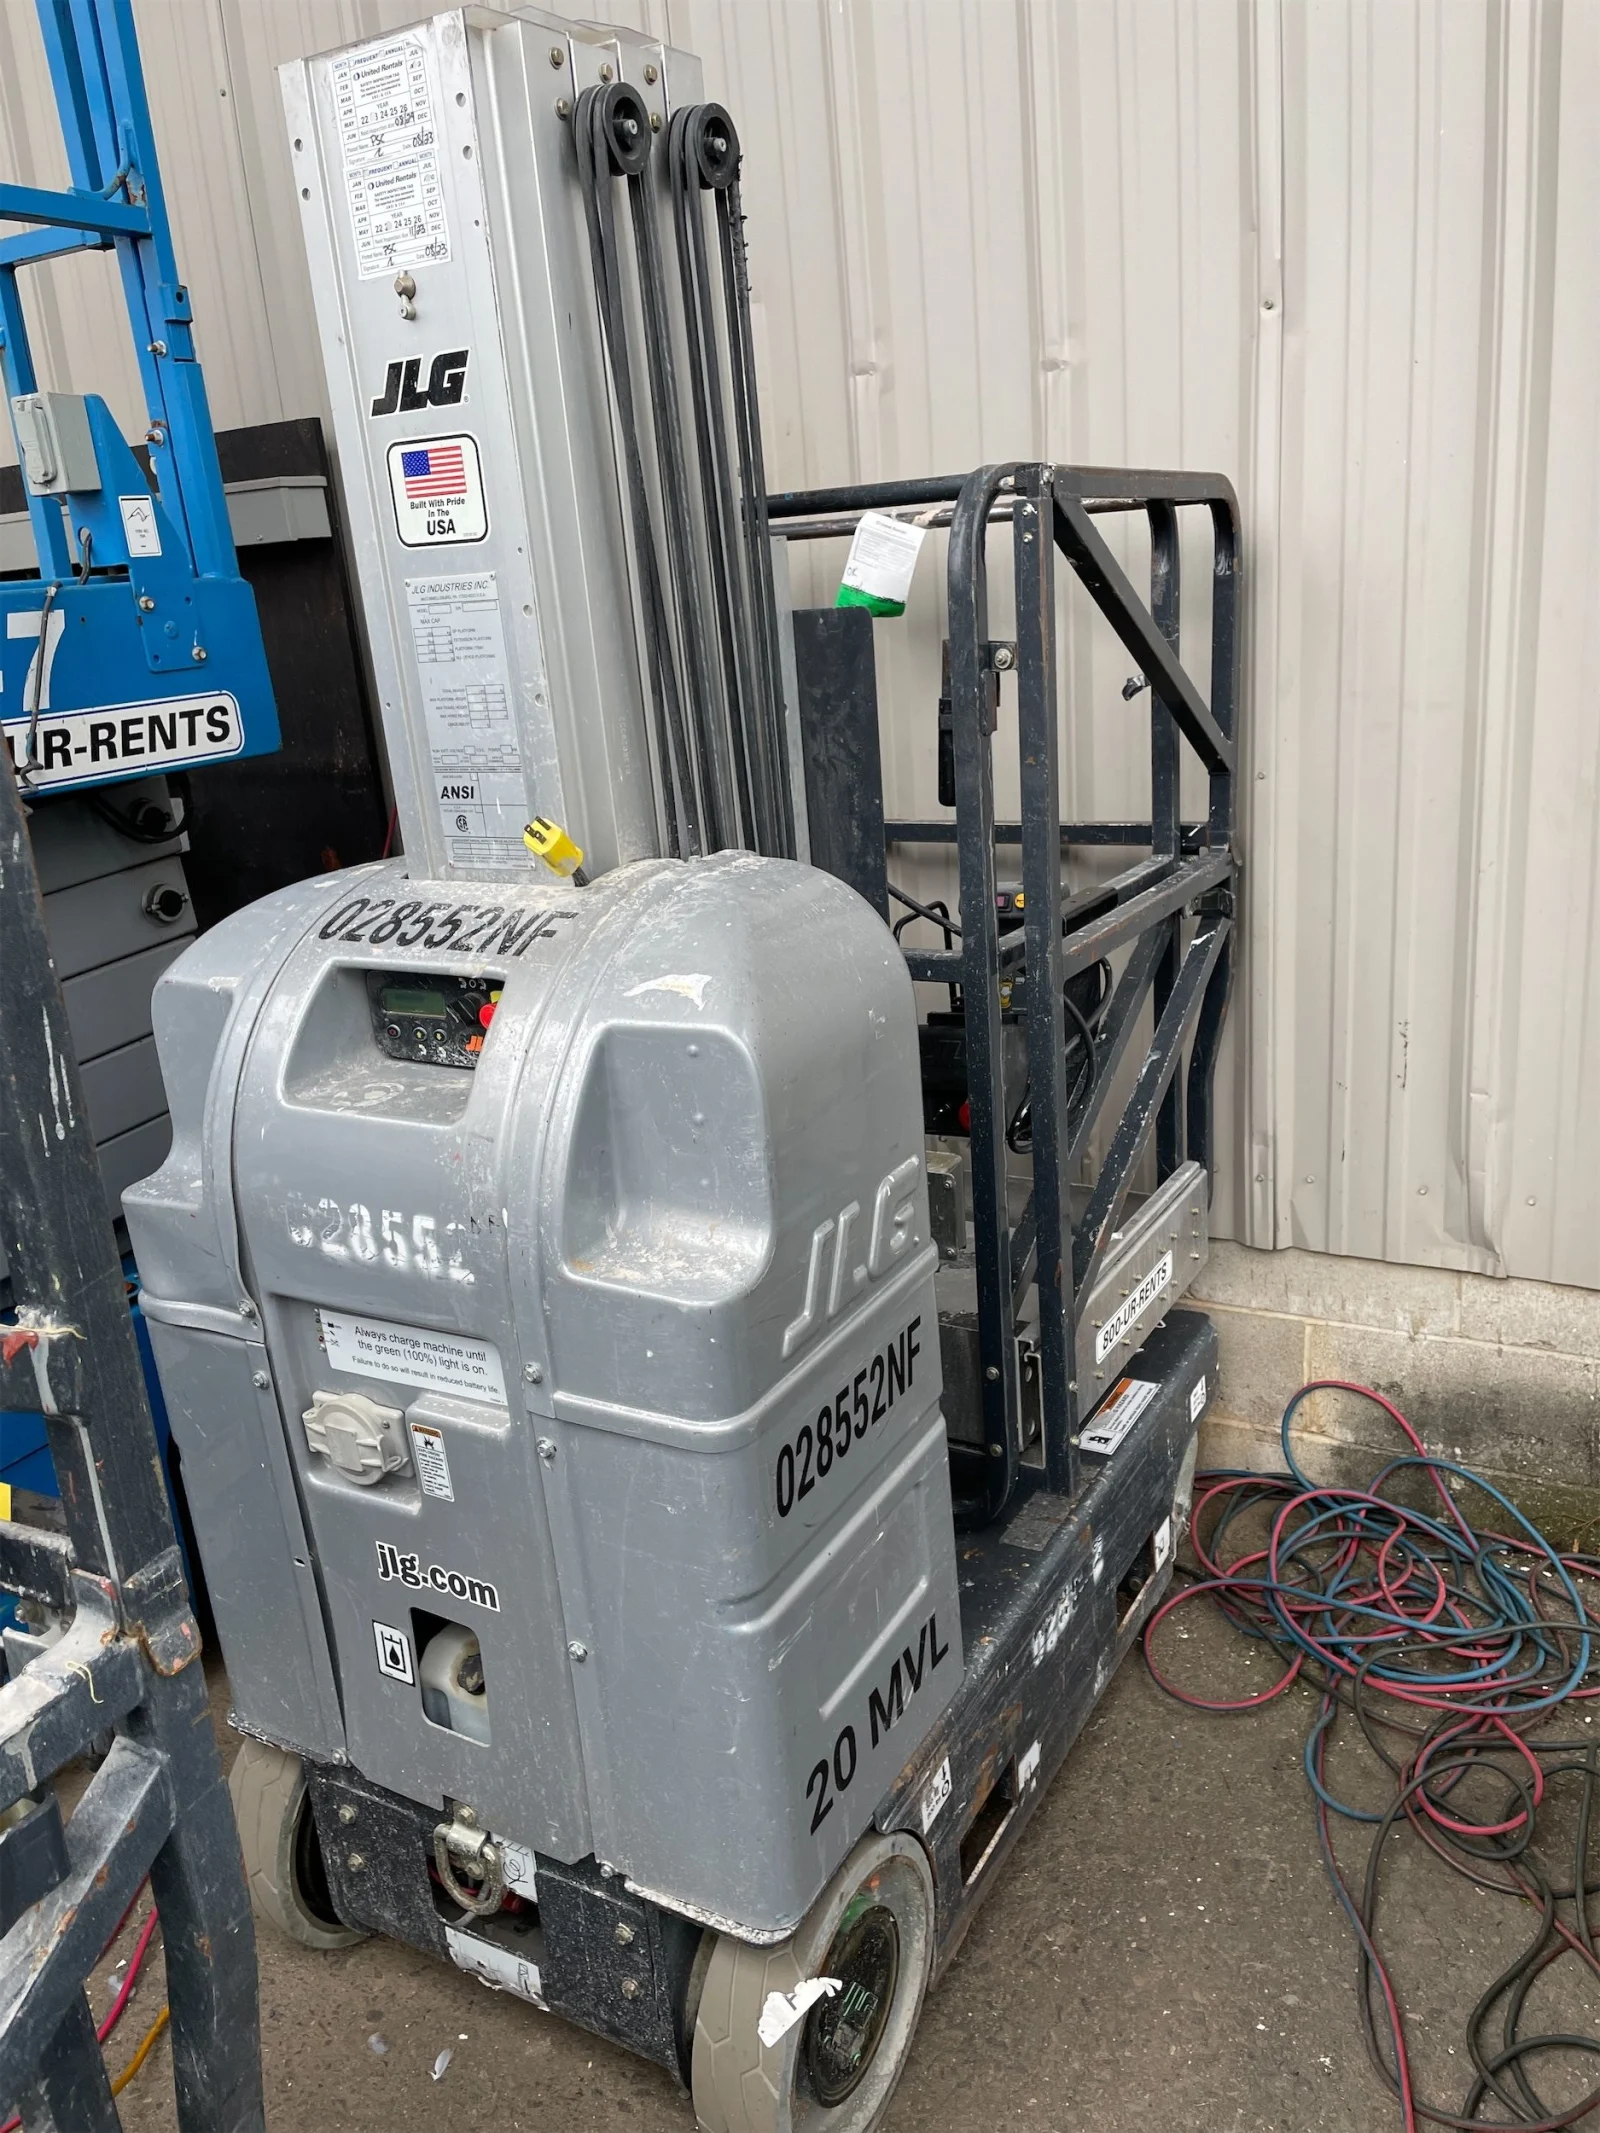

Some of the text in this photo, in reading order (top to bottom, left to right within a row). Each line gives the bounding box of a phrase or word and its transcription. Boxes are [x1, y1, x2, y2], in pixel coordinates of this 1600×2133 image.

[354, 45, 404, 65] FREQUENT ANNUAL
[409, 49, 418, 57] JUL
[361, 60, 403, 78] United Rentals
[412, 74, 423, 82] SEP
[340, 84, 349, 92] FEB
[414, 86, 424, 95] OCT
[340, 96, 352, 104] MAR
[376, 101, 389, 109] YEAR
[415, 99, 427, 107] NOV
[343, 108, 353, 116] APR
[361, 116, 369, 125] 22
[380, 110, 389, 119] 24
[390, 107, 398, 116] 25
[399, 104, 408, 113] 26
[417, 112, 428, 120] DEC
[346, 133, 357, 141] JUN
[369, 159, 418, 175] FREQUENT ANNUAL
[423, 162, 432, 170] JUL
[375, 172, 417, 188] United Rentals
[355, 204, 366, 212] MAR
[428, 199, 438, 207] OCT
[357, 216, 367, 224] APR
[375, 225, 383, 233] 22
[394, 220, 402, 229] 24
[404, 218, 412, 226] 25
[414, 215, 422, 224] 26
[371, 349, 470, 417] JLG
[410, 497, 466, 510] Built With Pride
[428, 508, 450, 518] In The
[427, 519, 456, 536] USA
[411, 585, 426, 595] JLG
[427, 581, 473, 594] INDUSTRIES
[440, 785, 474, 800] ANSI
[318, 898, 579, 957] 028552NF
[1102, 1261, 1167, 1351] 800-UR-RENTS
[354, 1325, 487, 1362] Always charge machine until
[358, 1340, 488, 1376] the green (100%) light is on.
[352, 1355, 501, 1394] Failure to do so will result in reduced battery life.
[776, 1316, 921, 1518] 028552NF
[376, 1542, 499, 1610] jlg.com
[806, 1613, 949, 1836] 20 MVL
